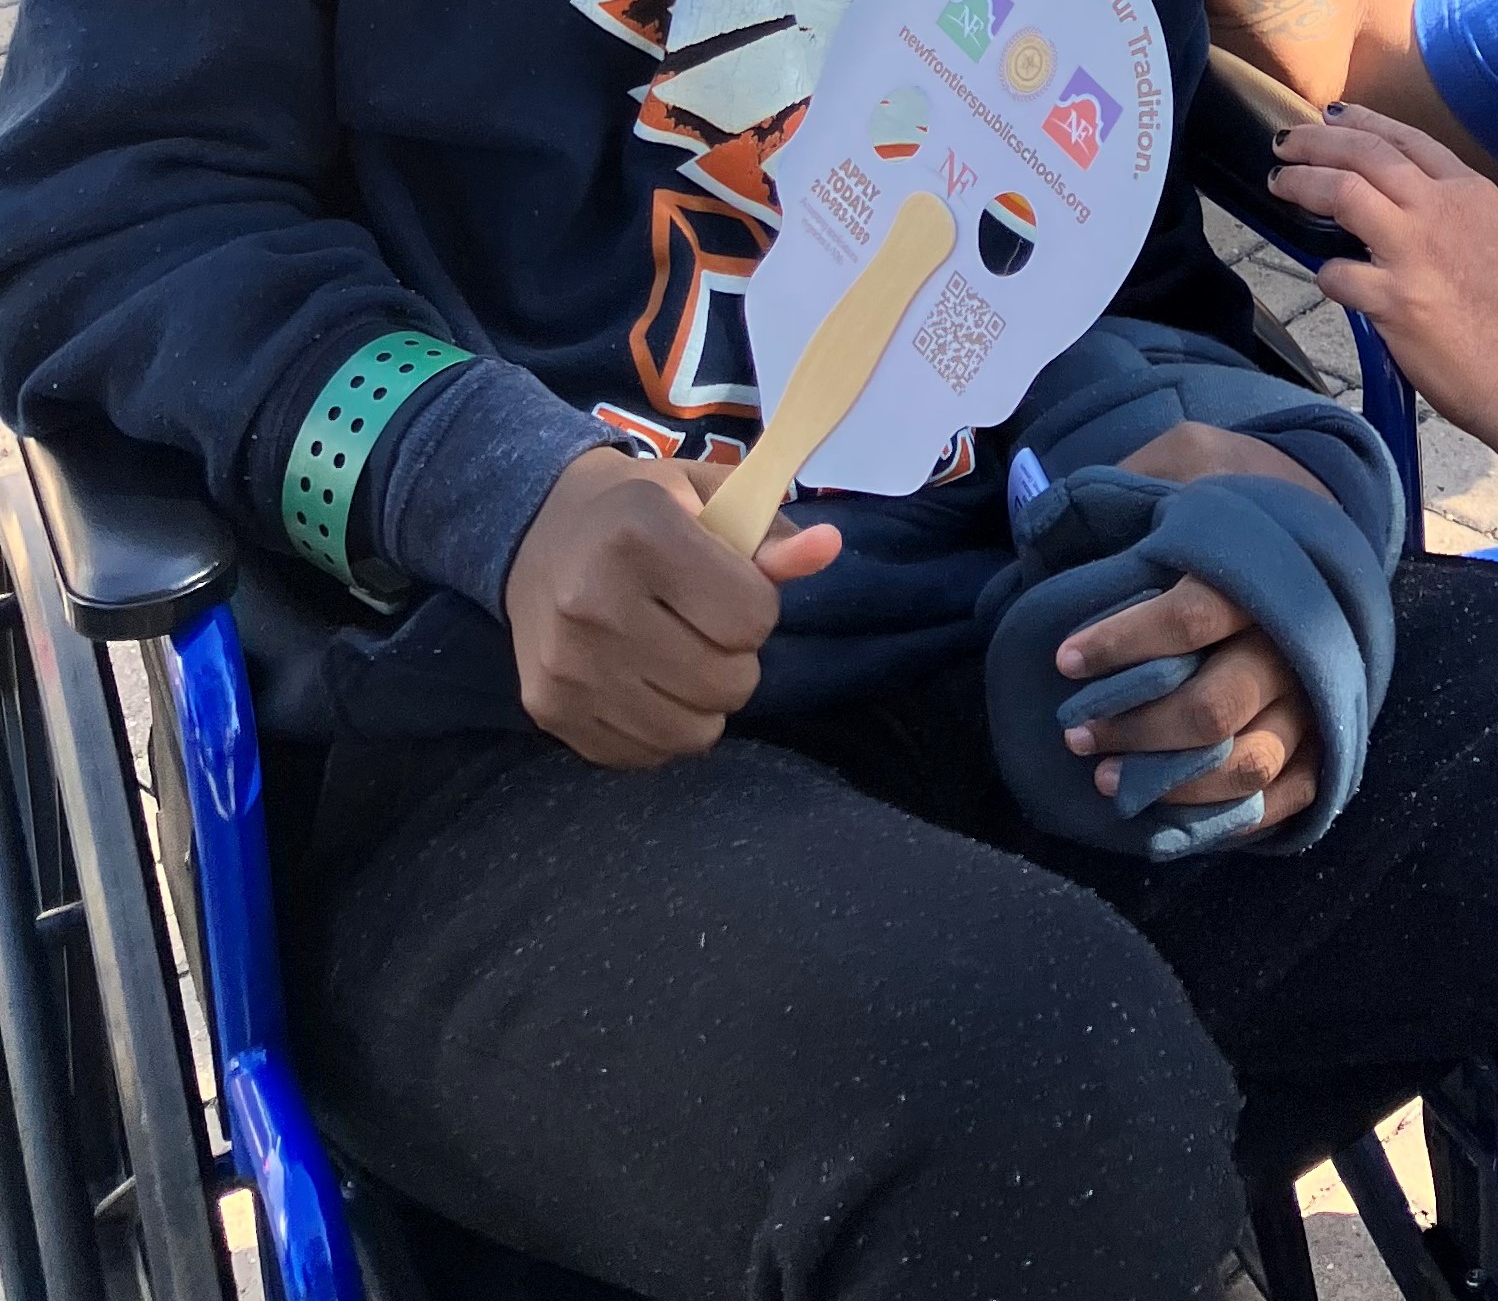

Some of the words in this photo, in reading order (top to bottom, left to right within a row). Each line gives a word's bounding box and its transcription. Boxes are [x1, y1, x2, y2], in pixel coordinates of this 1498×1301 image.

[899, 24, 1092, 226] newfrontierspublicschools.org
[1127, 26, 1163, 181] Tradition.
[825, 167, 874, 225] TODAY!
[838, 157, 881, 202] APPLY
